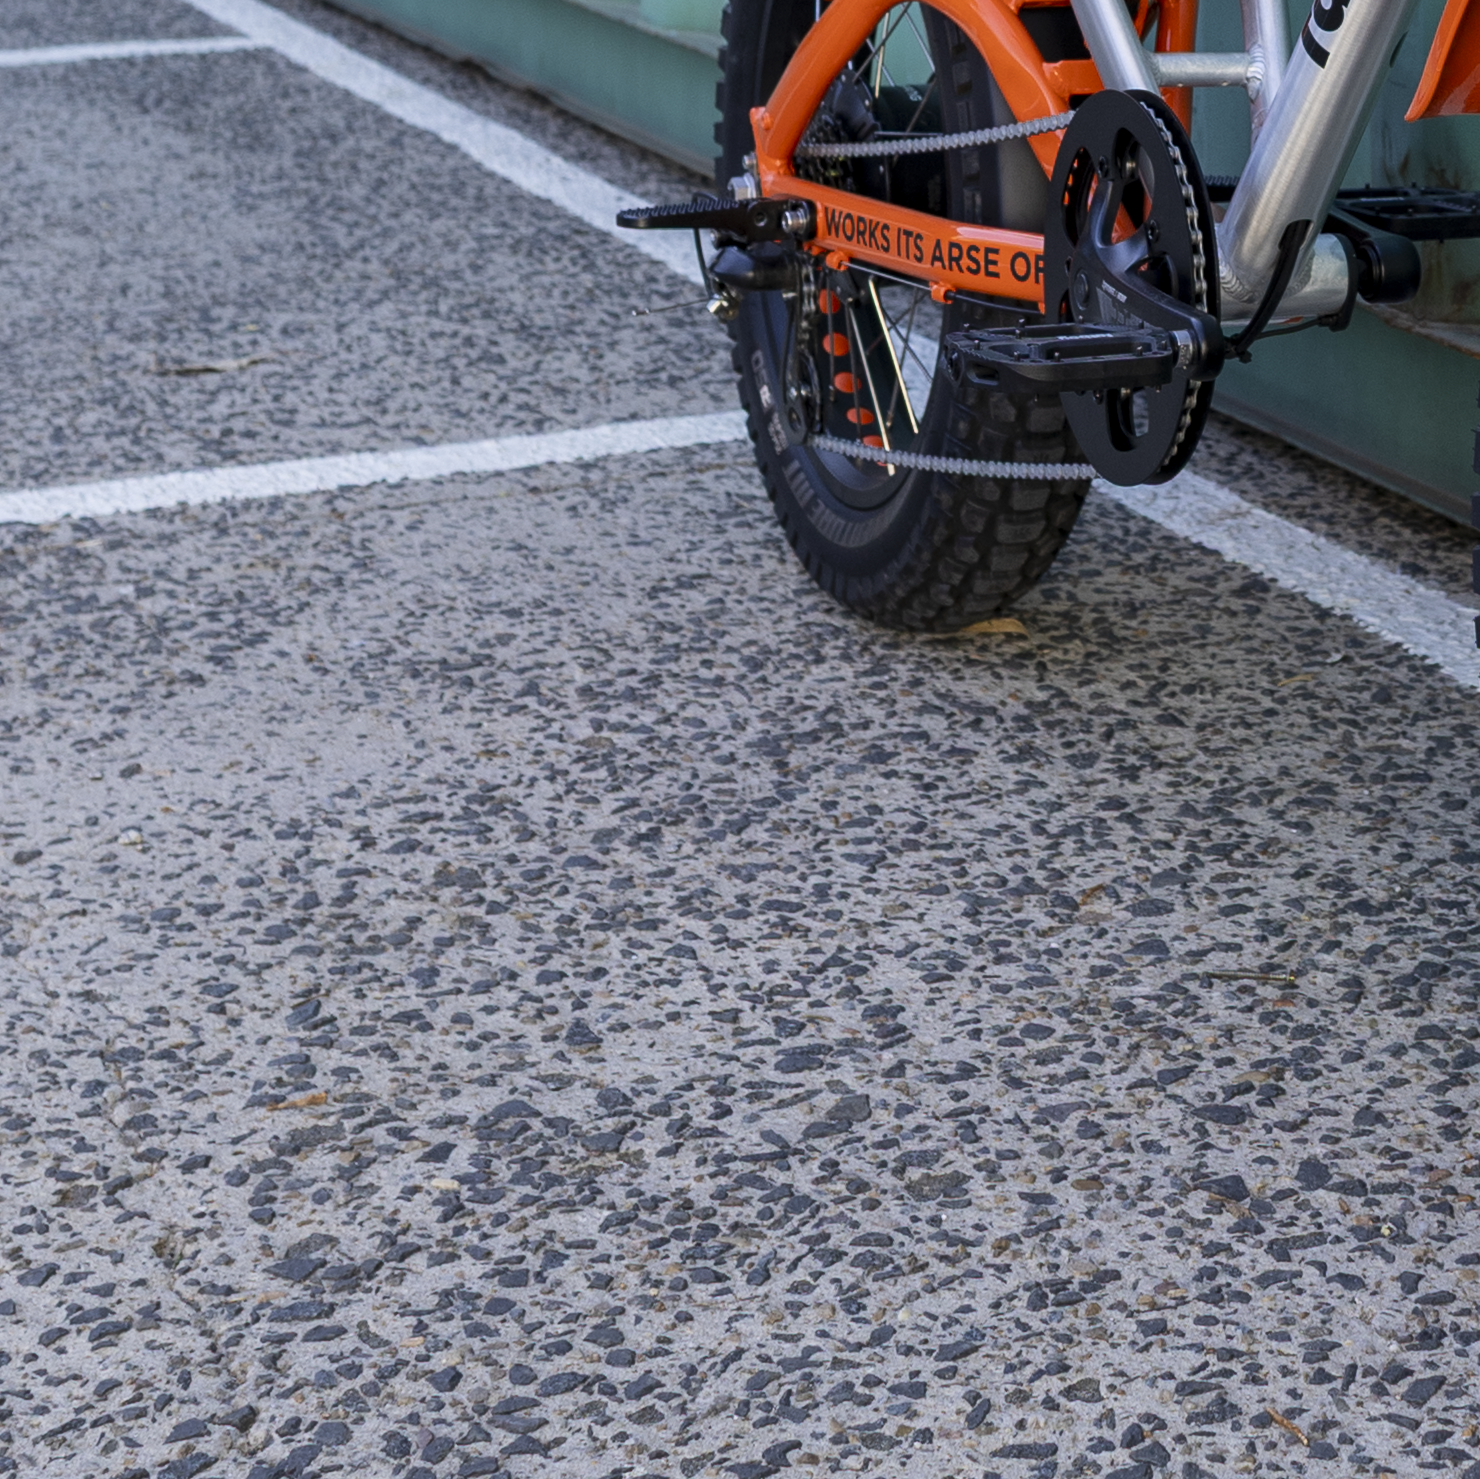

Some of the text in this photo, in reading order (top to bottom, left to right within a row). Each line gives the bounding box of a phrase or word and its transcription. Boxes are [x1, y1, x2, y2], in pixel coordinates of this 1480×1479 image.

[824, 206, 891, 254] WORKS
[896, 226, 924, 263] ITS
[930, 238, 1000, 279] ARSE
